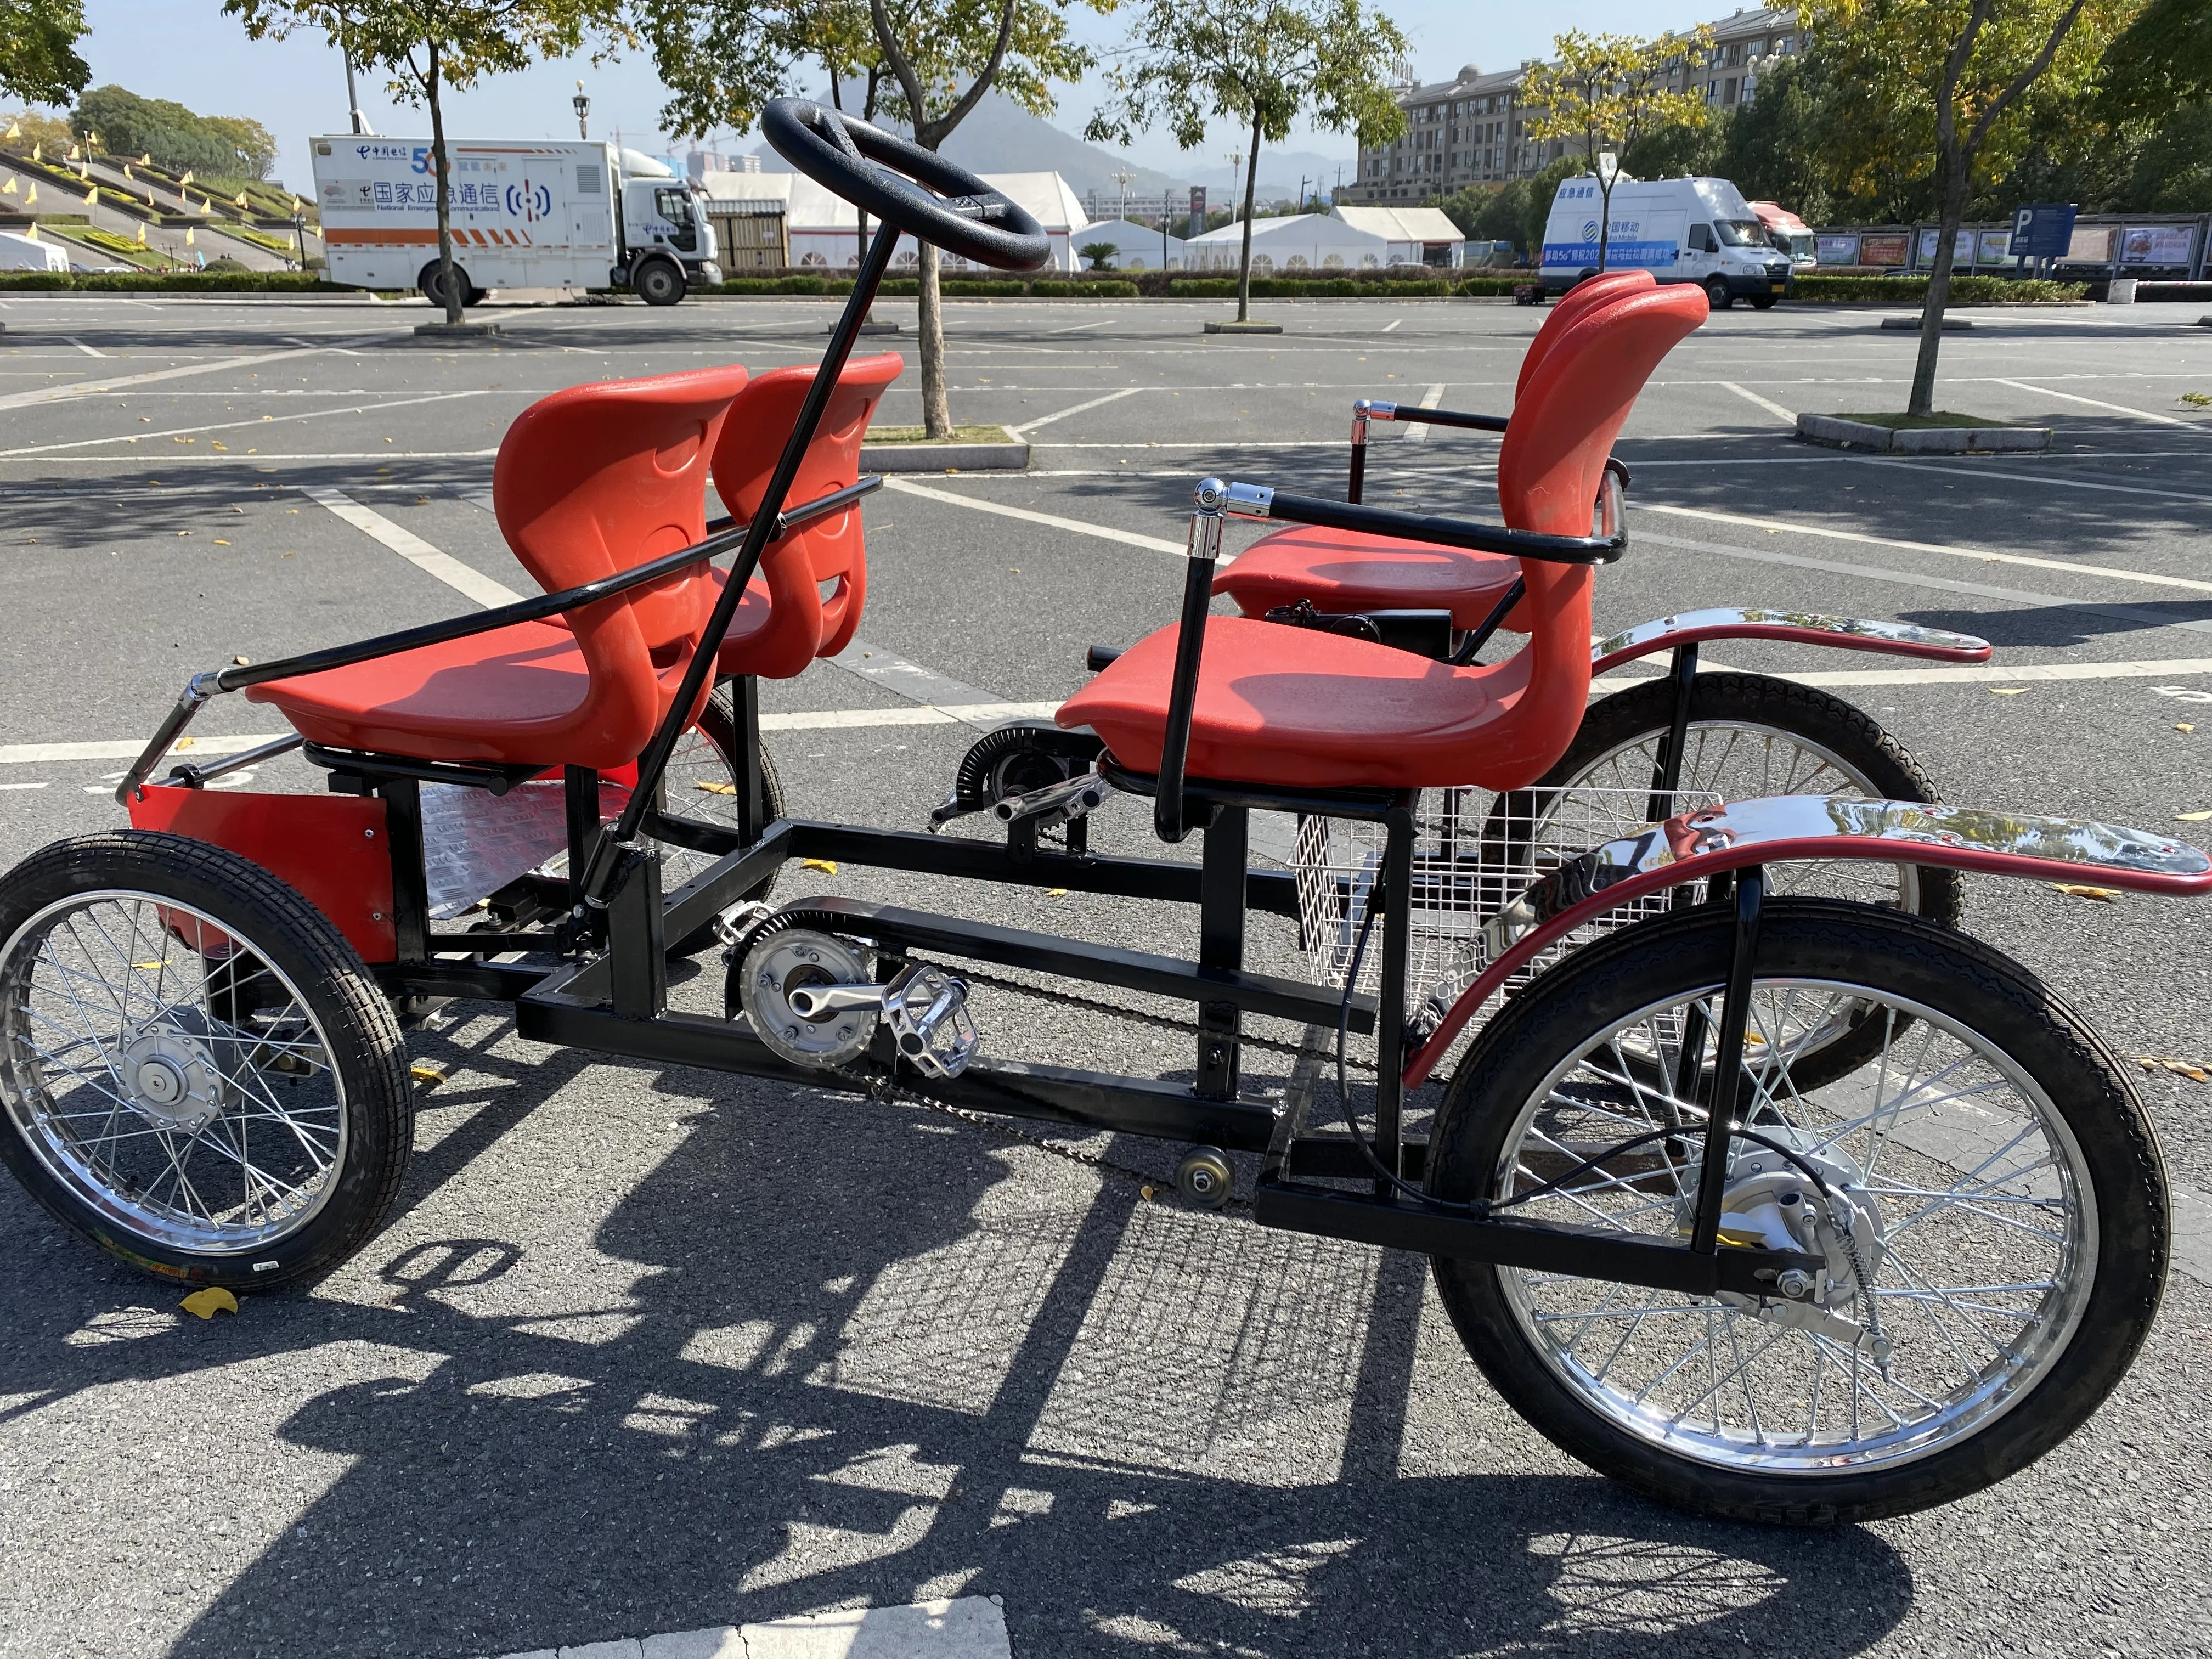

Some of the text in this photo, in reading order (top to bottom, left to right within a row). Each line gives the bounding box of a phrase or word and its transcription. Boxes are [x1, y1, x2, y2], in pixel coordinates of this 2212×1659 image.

[373, 146, 406, 156] 中国电信
[1559, 187, 1594, 198] 应急通信
[2016, 209, 2033, 235] P
